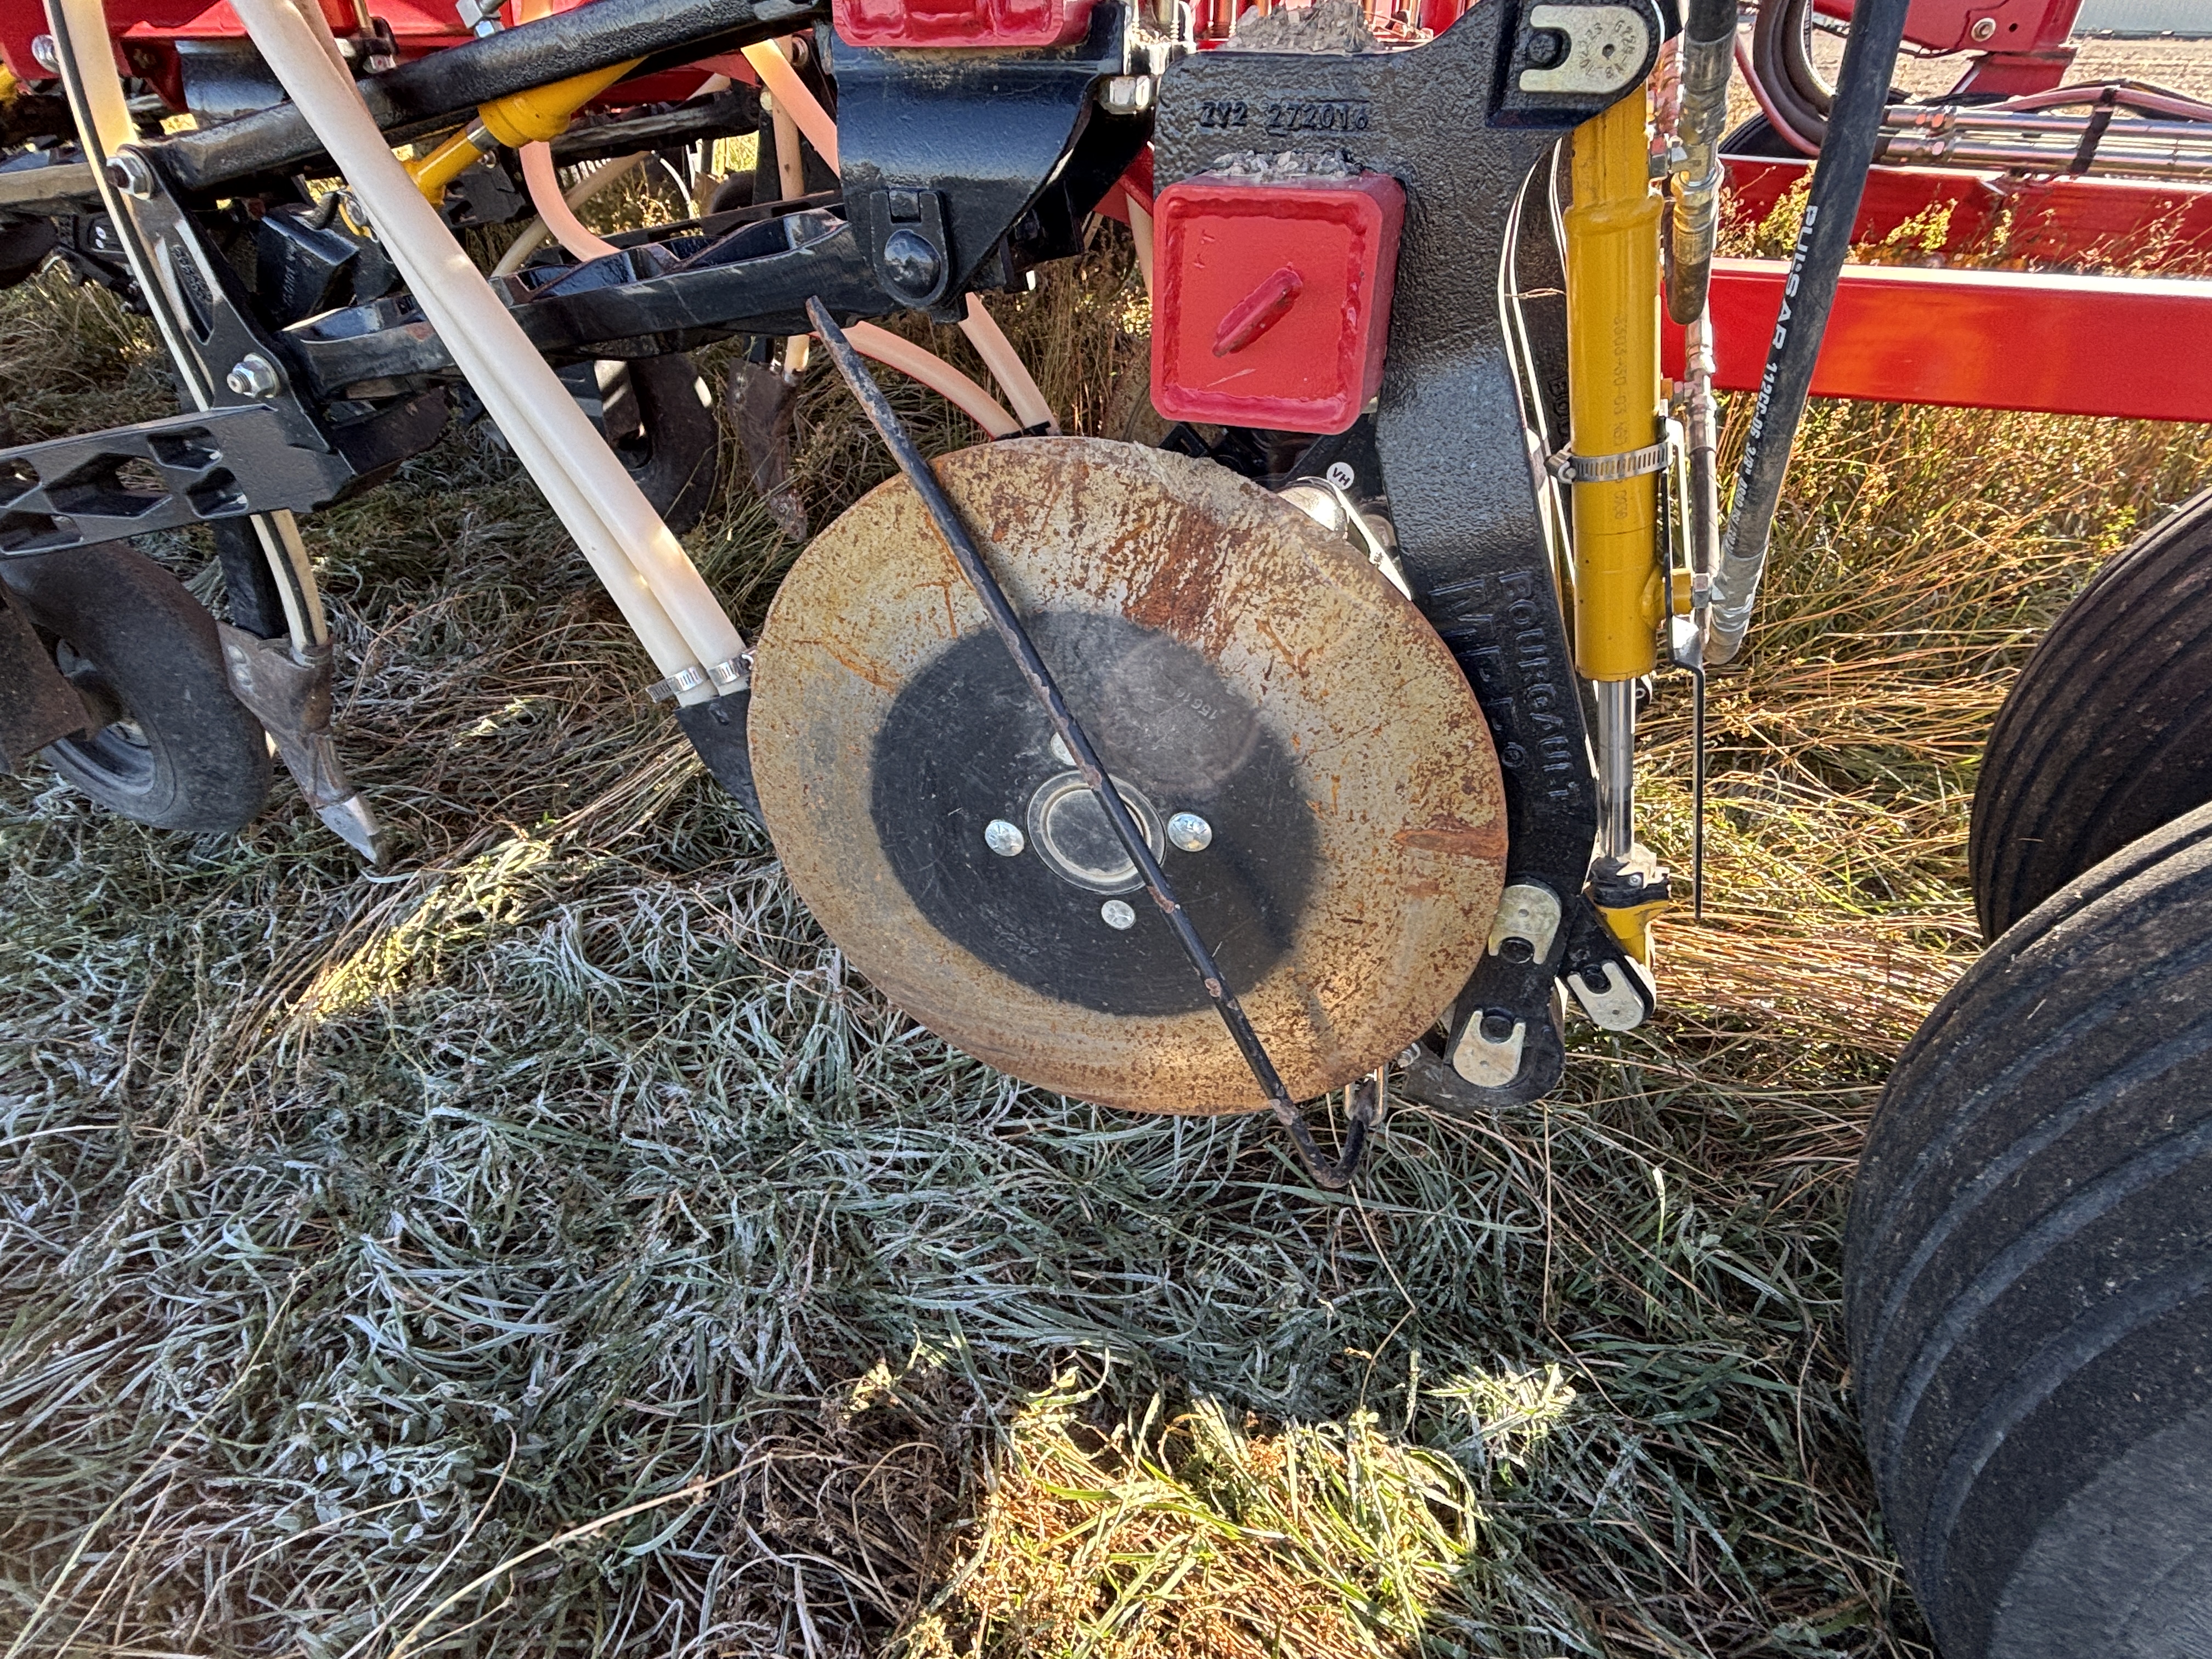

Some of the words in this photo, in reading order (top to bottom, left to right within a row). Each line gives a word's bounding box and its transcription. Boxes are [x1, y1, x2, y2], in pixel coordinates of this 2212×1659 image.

[1772, 205, 1819, 351] PULSAR
[1750, 362, 1778, 439] 112CC-06
[1332, 467, 1351, 487] VH
